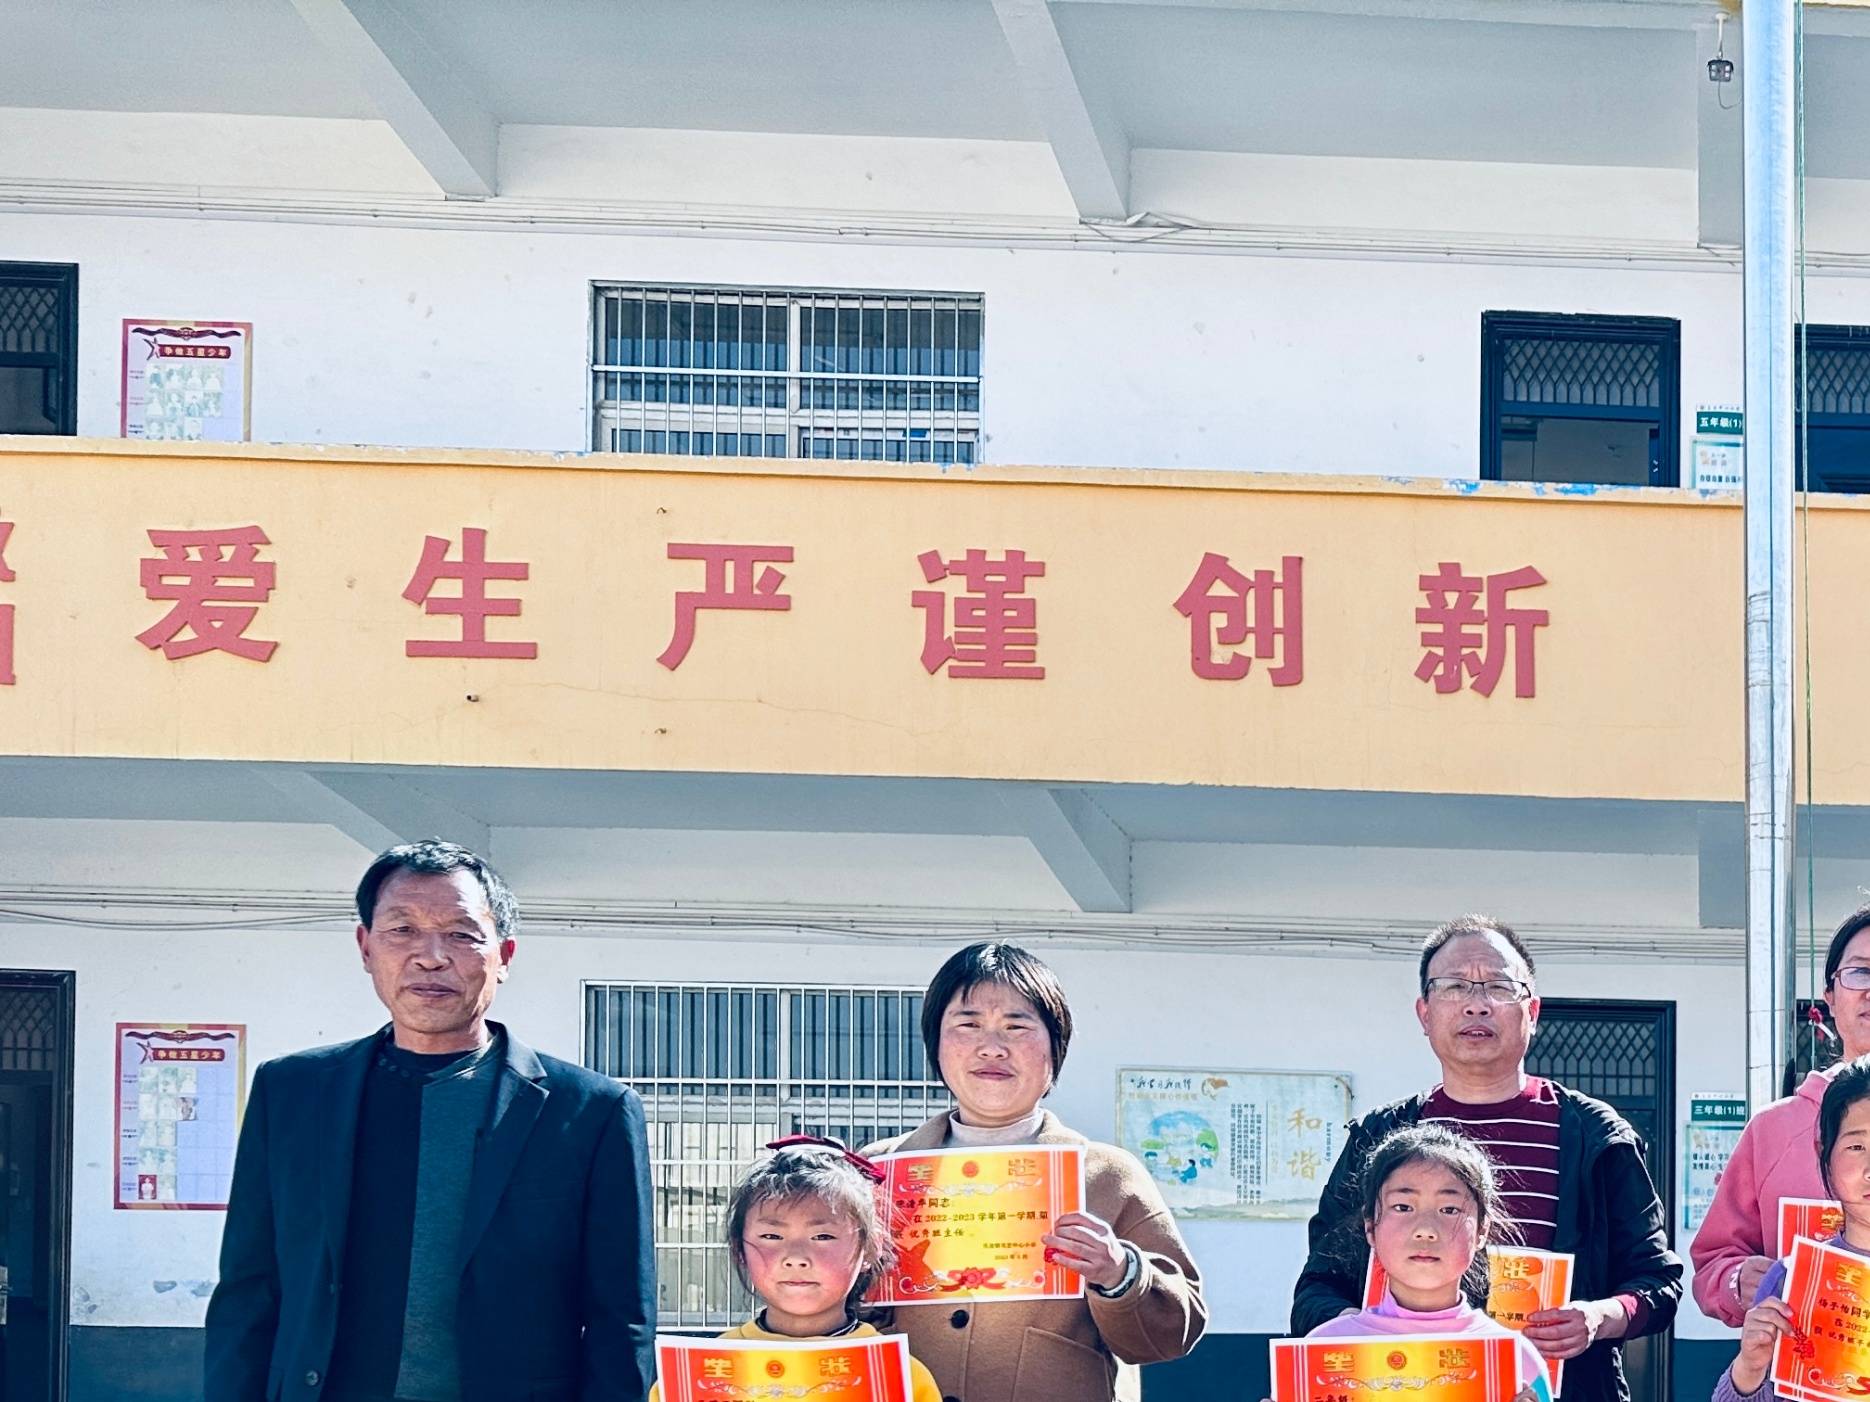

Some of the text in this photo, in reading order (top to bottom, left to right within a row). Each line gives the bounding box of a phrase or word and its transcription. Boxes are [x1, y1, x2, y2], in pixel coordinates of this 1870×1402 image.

[0, 506, 1549, 698] 爱生严谨创新
[1286, 1107, 1323, 1181] 和谐
